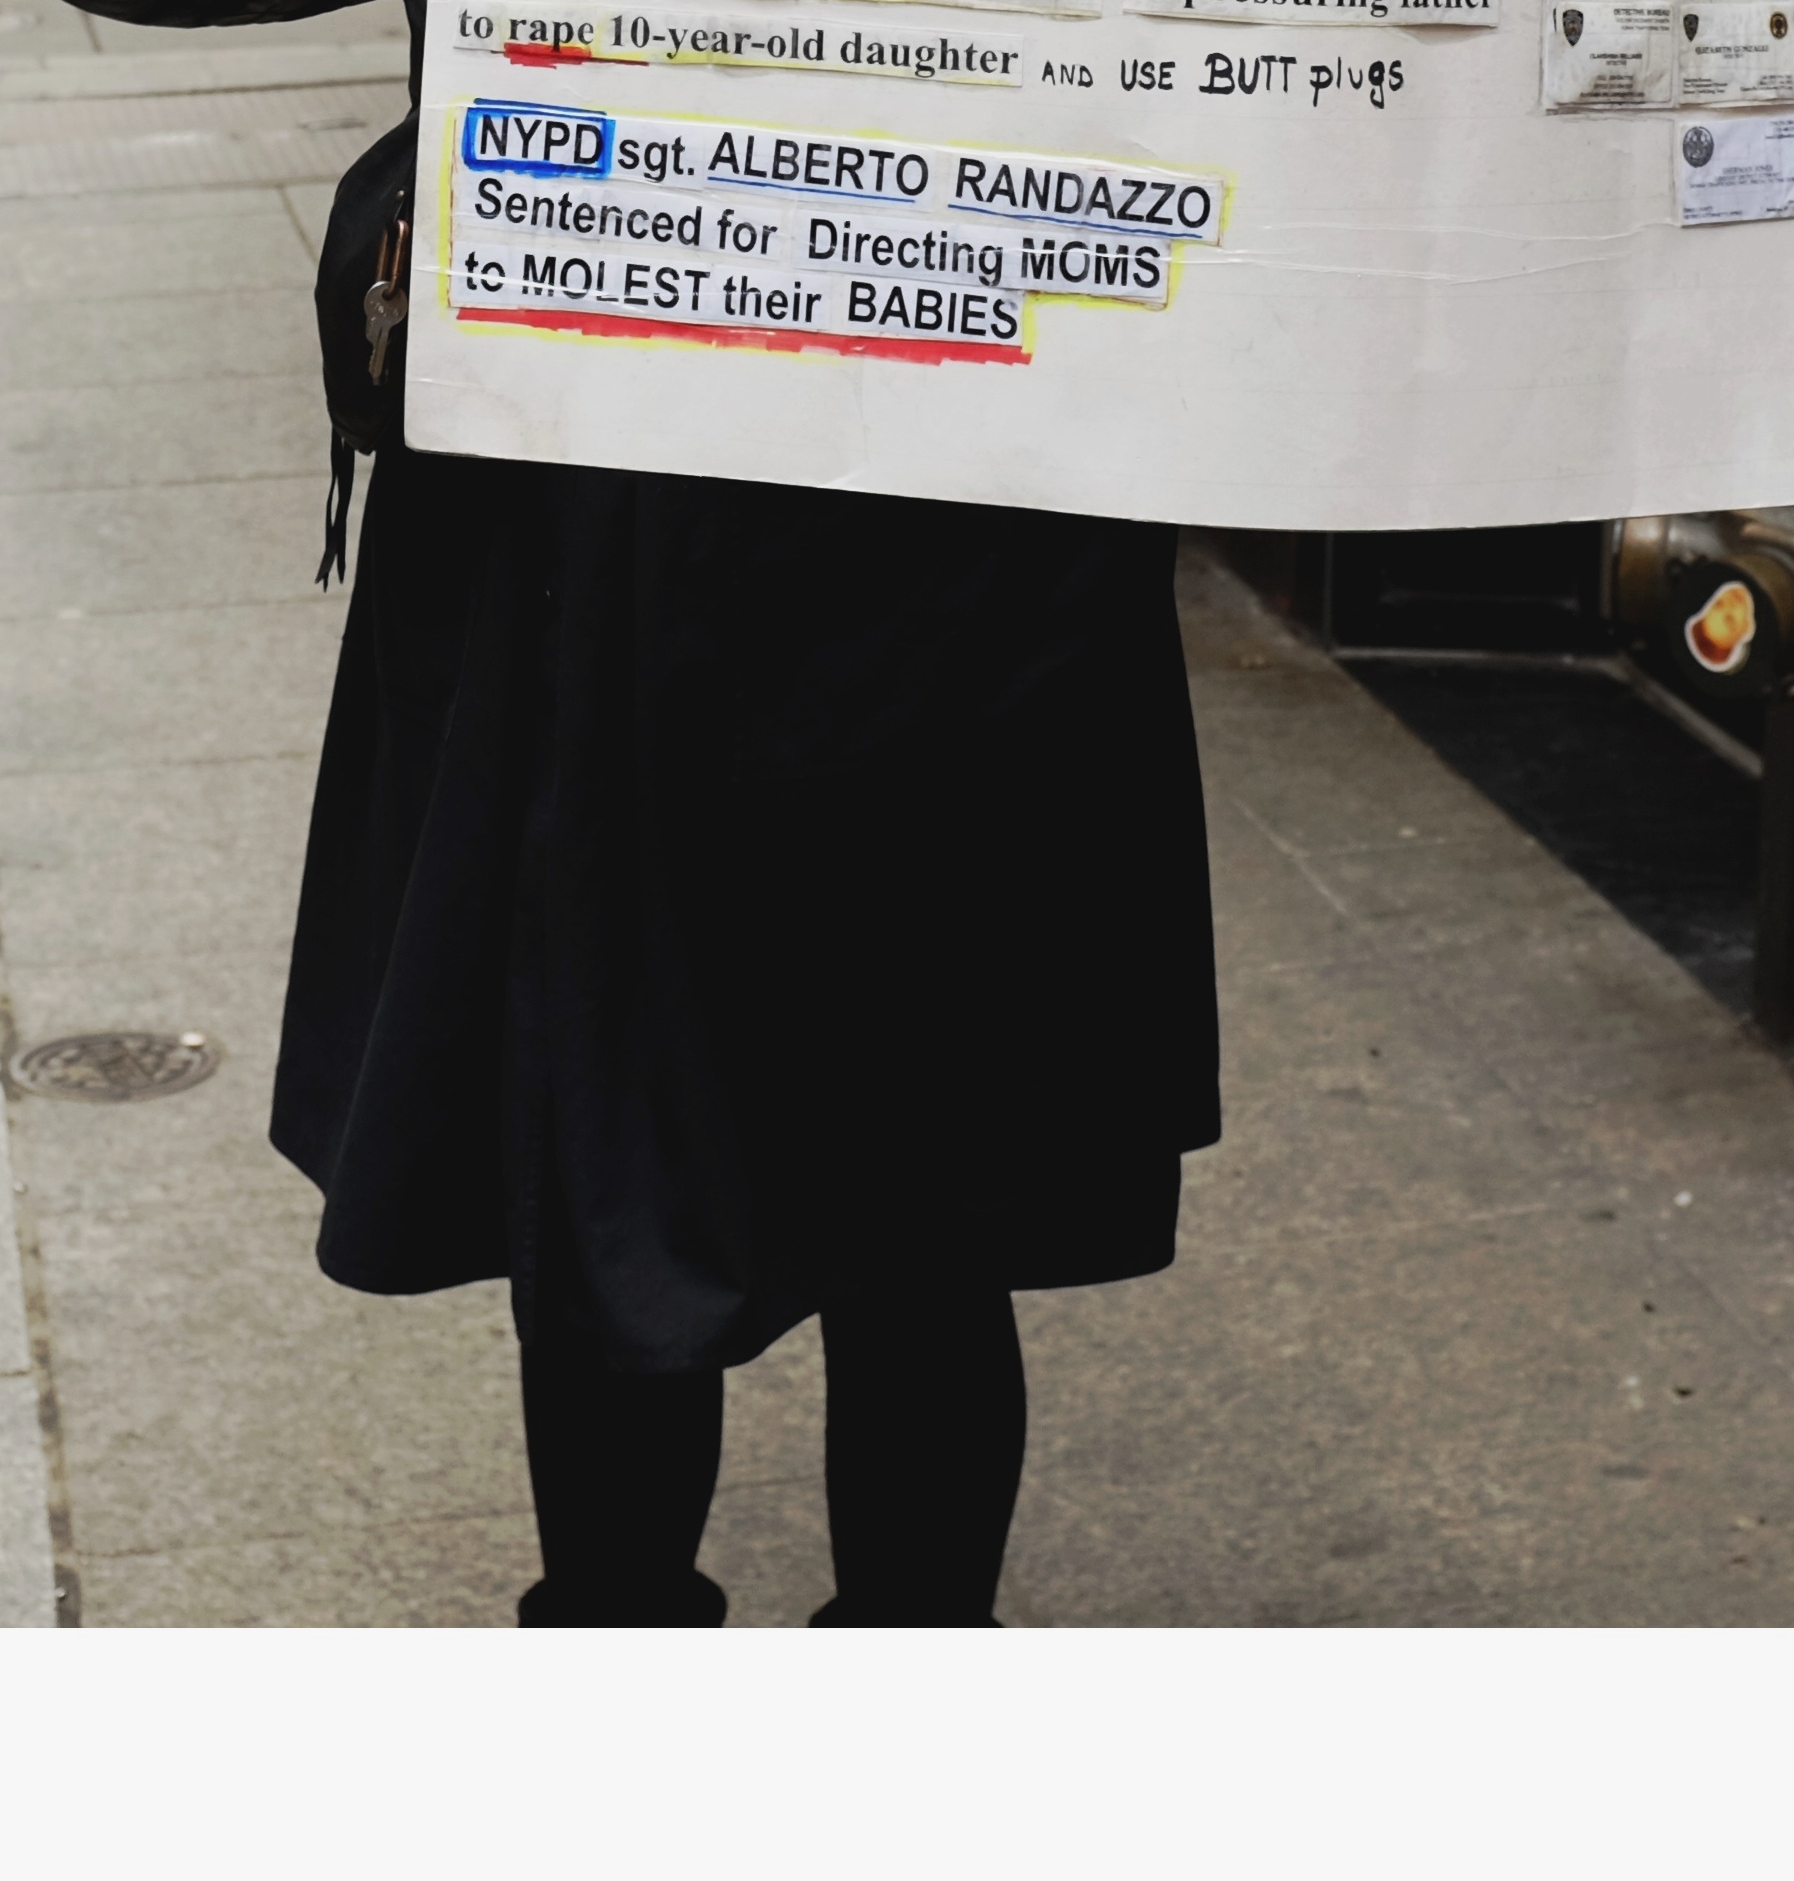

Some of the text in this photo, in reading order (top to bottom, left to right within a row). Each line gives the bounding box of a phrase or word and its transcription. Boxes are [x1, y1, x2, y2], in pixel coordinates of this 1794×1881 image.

[459, 8, 1405, 109] to rape 10-year-old daughter AND USE BUTT plugs
[479, 114, 1211, 228] NYPD sgt. ALBERTO RANDAZZO
[475, 178, 1161, 289] Sentenced for Directing MOMS
[465, 252, 1018, 339] to MOLEST their BABIES
